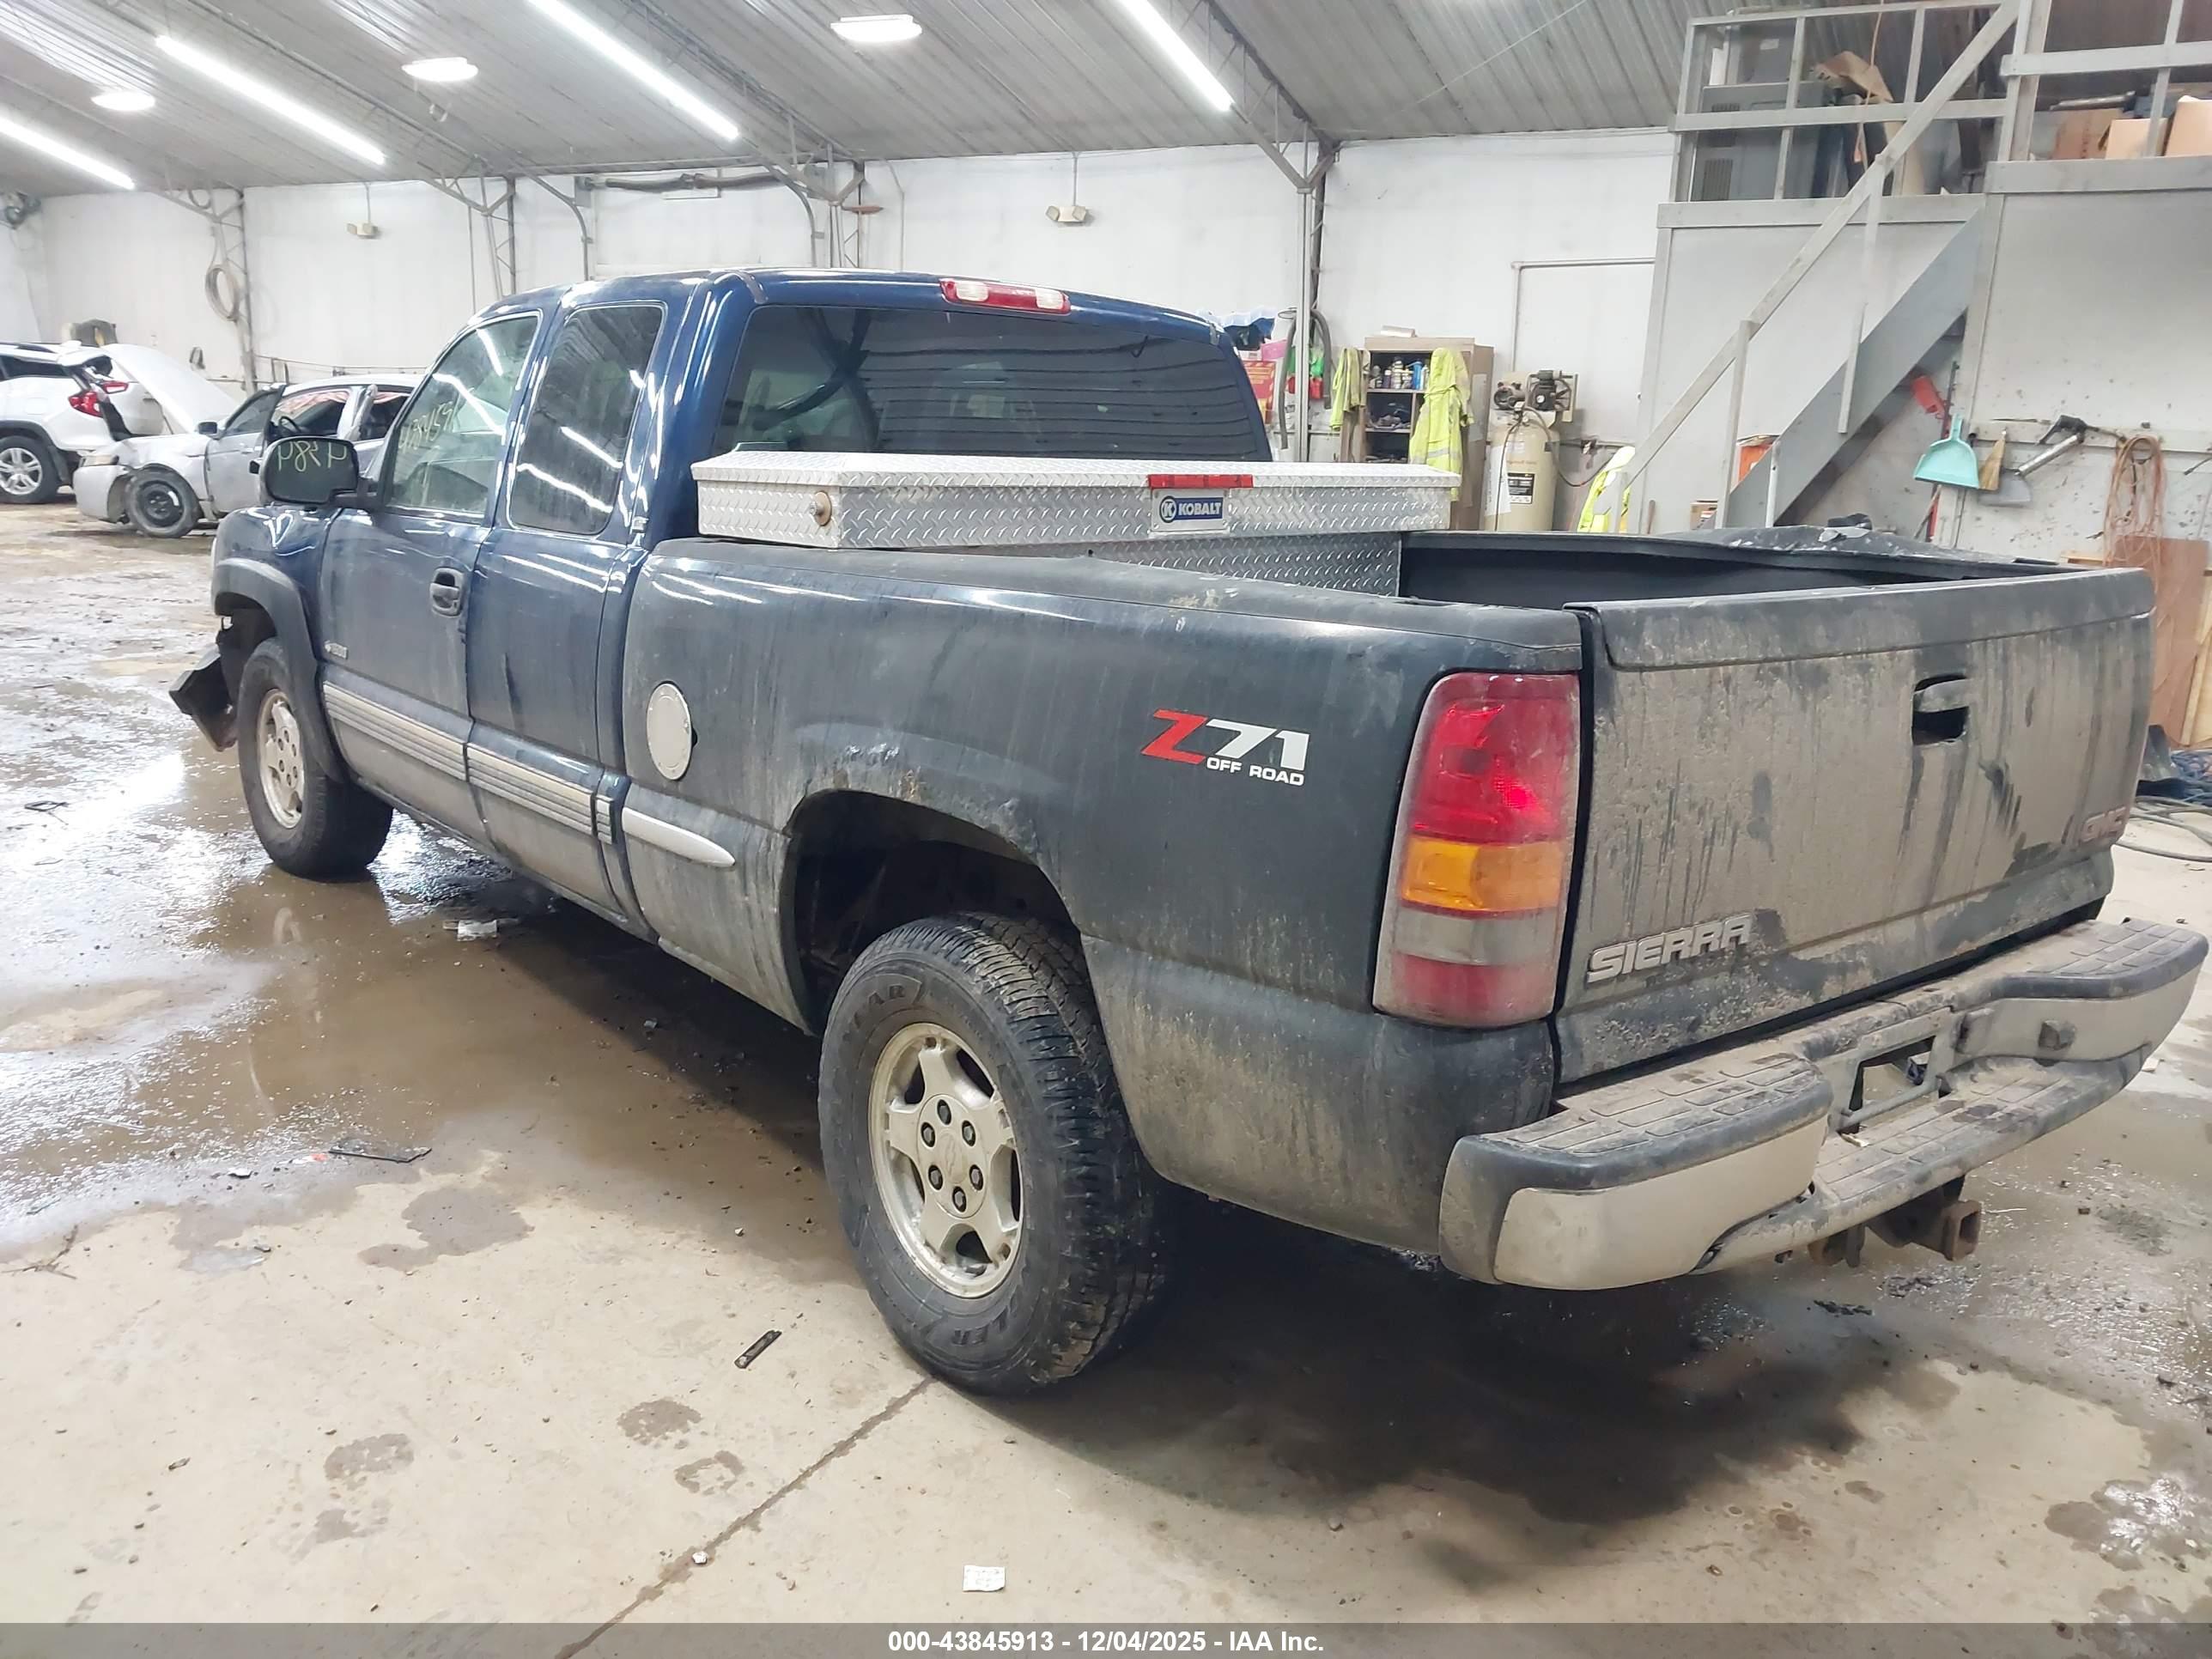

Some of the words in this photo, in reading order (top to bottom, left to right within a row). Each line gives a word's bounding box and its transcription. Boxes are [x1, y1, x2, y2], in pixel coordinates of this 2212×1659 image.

[1177, 501, 1222, 516] KOBALT
[1140, 709, 1310, 771] Z71
[1206, 757, 1243, 774] OFF
[1249, 764, 1305, 787] ROAD
[1587, 913, 1753, 983] SIERRA
